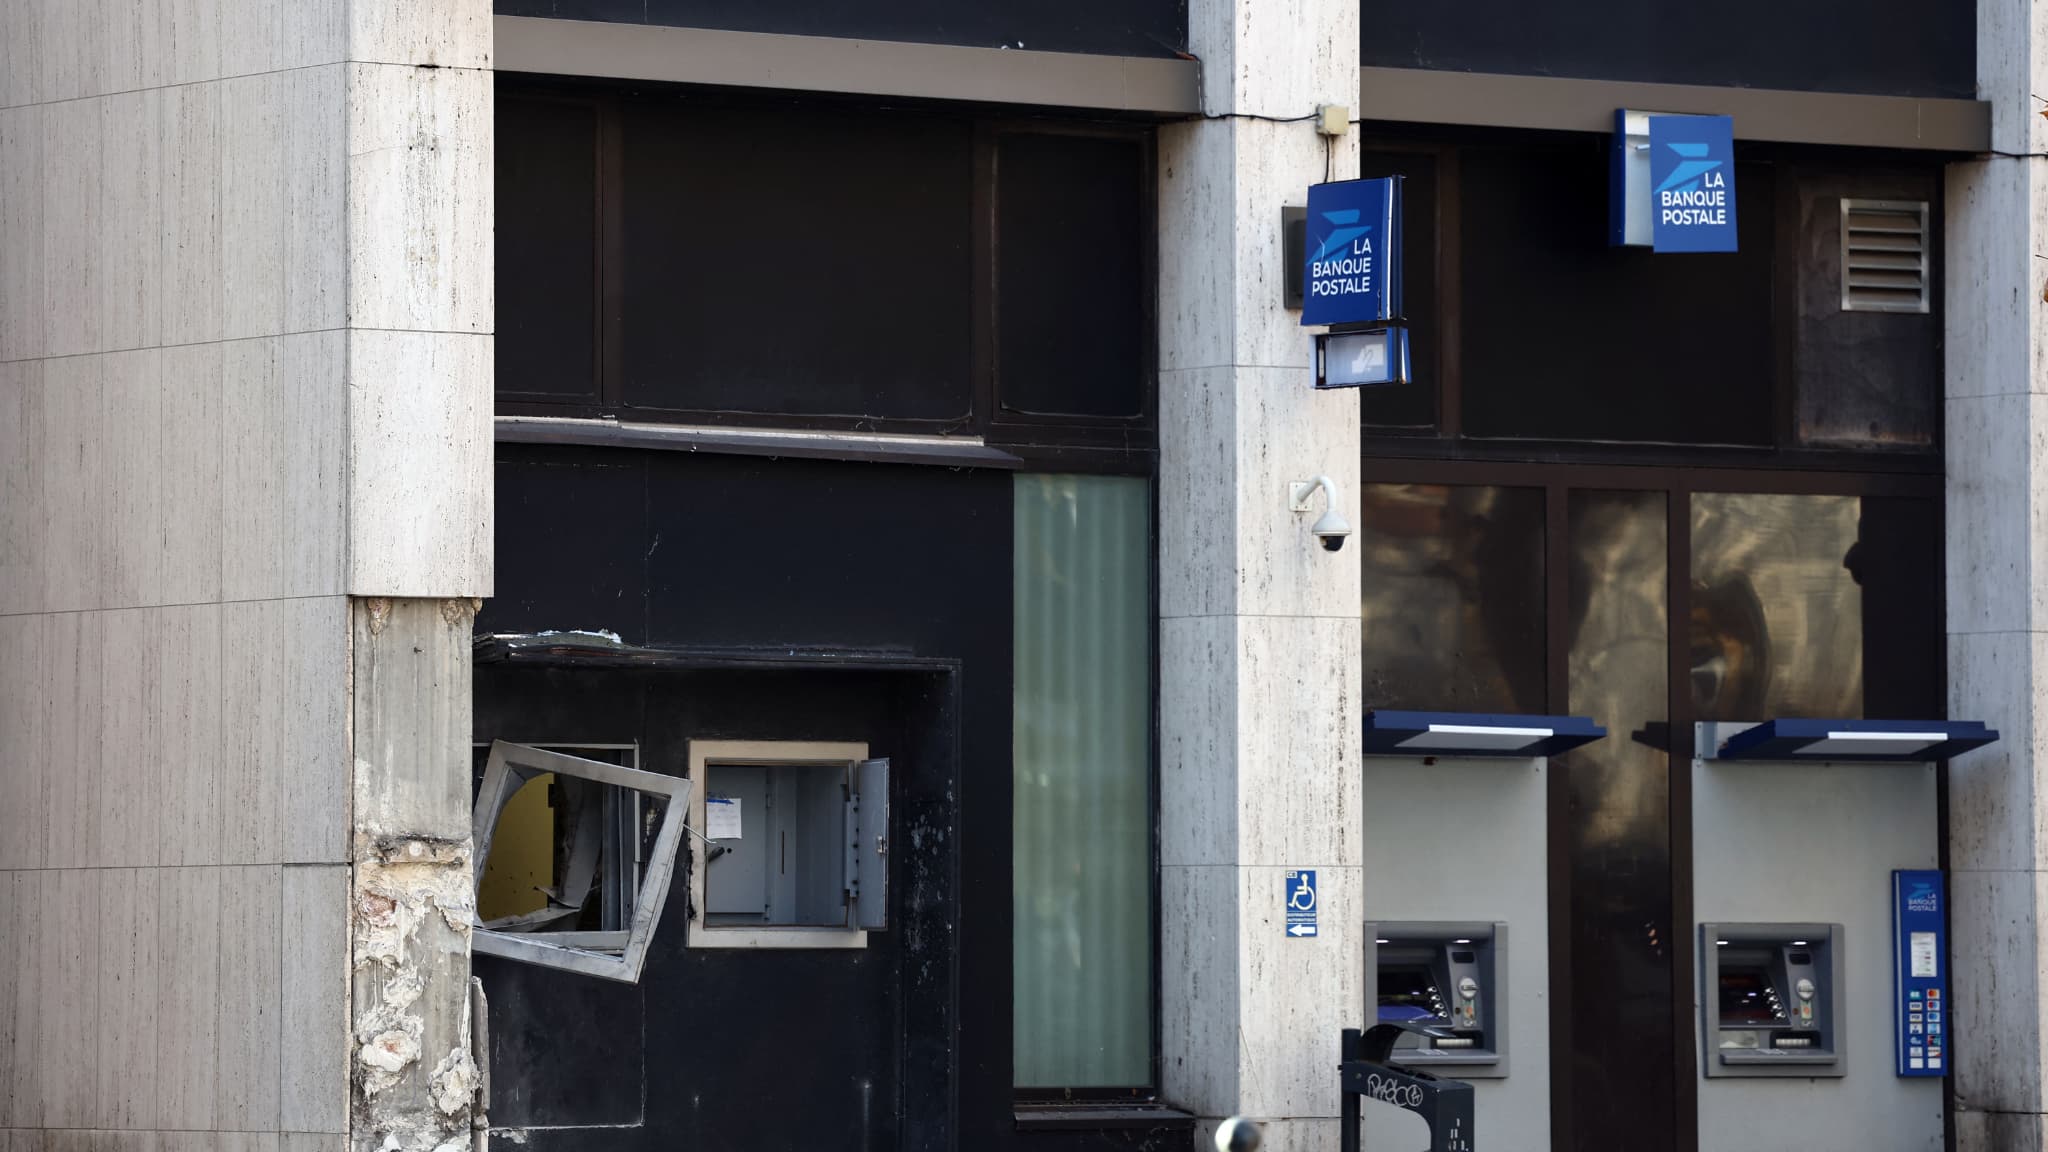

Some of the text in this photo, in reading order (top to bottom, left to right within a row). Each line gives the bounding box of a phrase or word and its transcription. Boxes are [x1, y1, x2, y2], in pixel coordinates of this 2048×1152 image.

[1705, 172, 1725, 188] LA
[1662, 190, 1726, 207] BANQUE
[1662, 209, 1727, 225] POSTALE
[1354, 238, 1372, 255] LA
[1313, 257, 1372, 278] BANQUE
[1312, 276, 1371, 297] POSTALE
